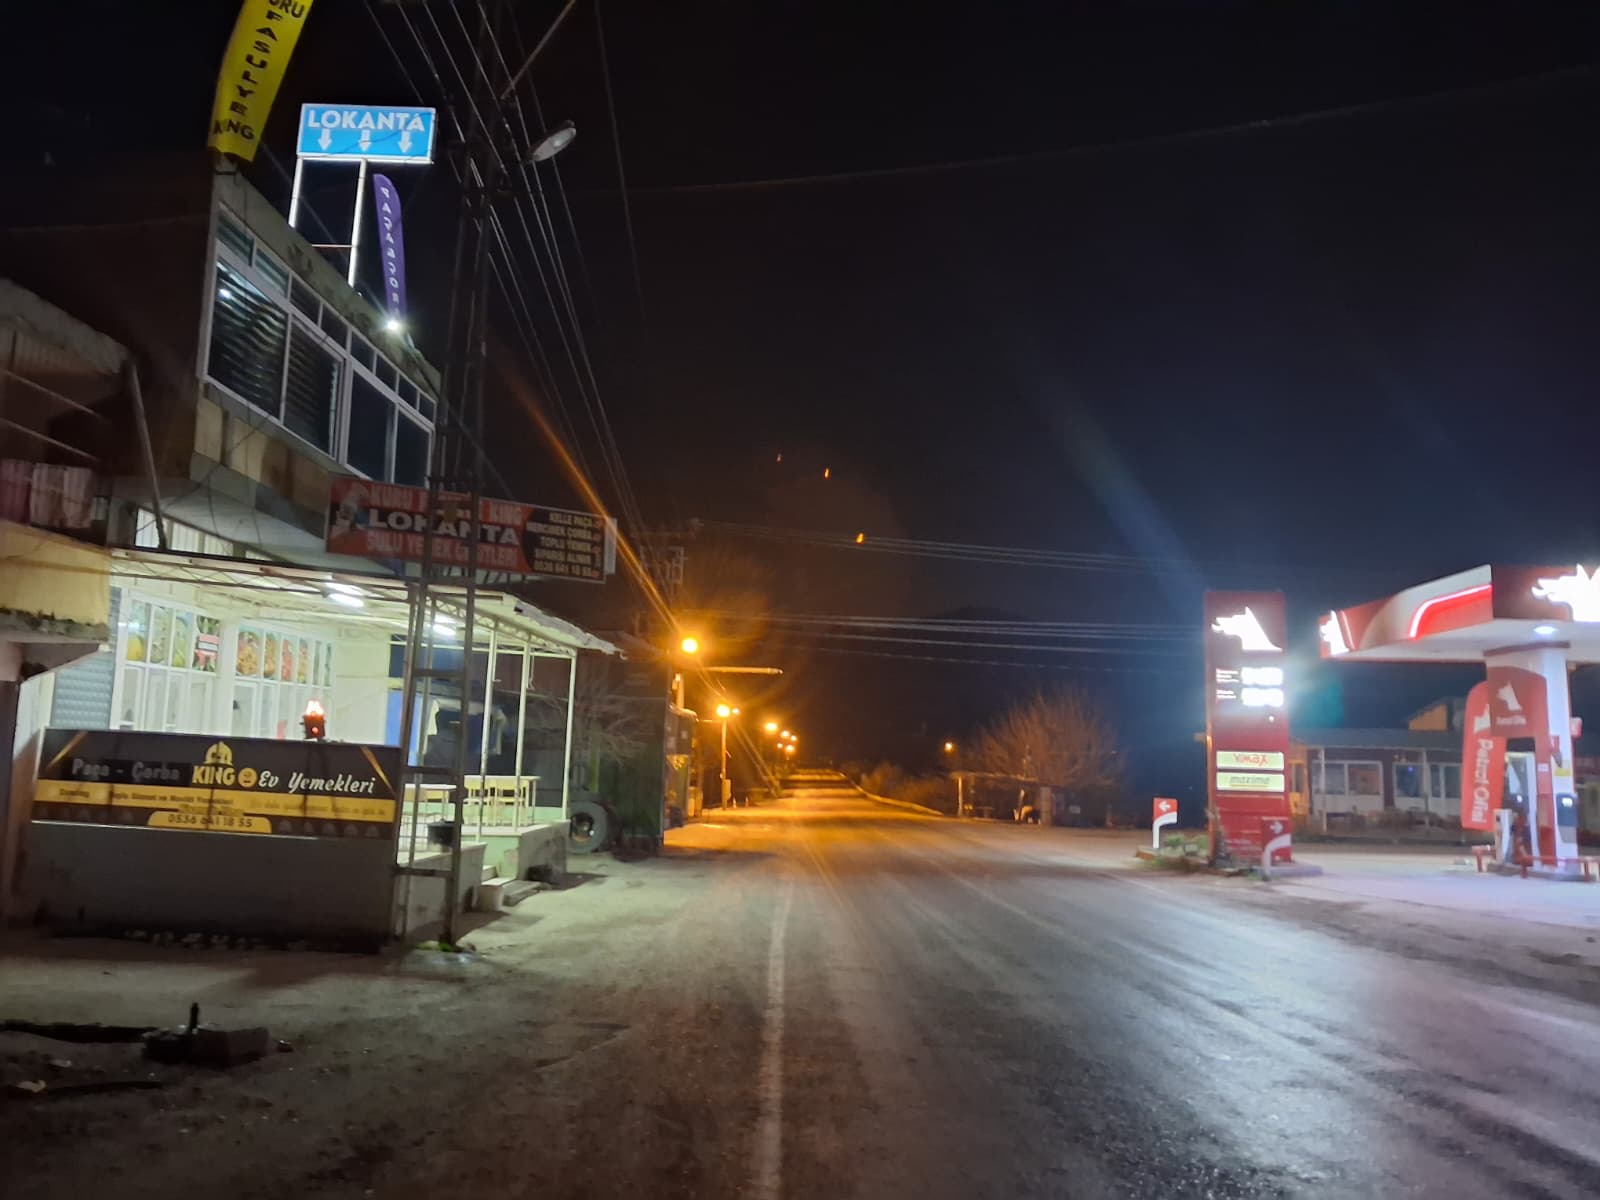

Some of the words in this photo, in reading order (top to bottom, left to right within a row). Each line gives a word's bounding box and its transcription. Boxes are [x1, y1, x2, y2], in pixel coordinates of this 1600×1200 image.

[308, 109, 425, 132] LOKANTA
[367, 507, 520, 545] LOKANTA
[191, 765, 236, 786] KING
[258, 770, 280, 788] Ev
[288, 772, 377, 795] Yemekleri
